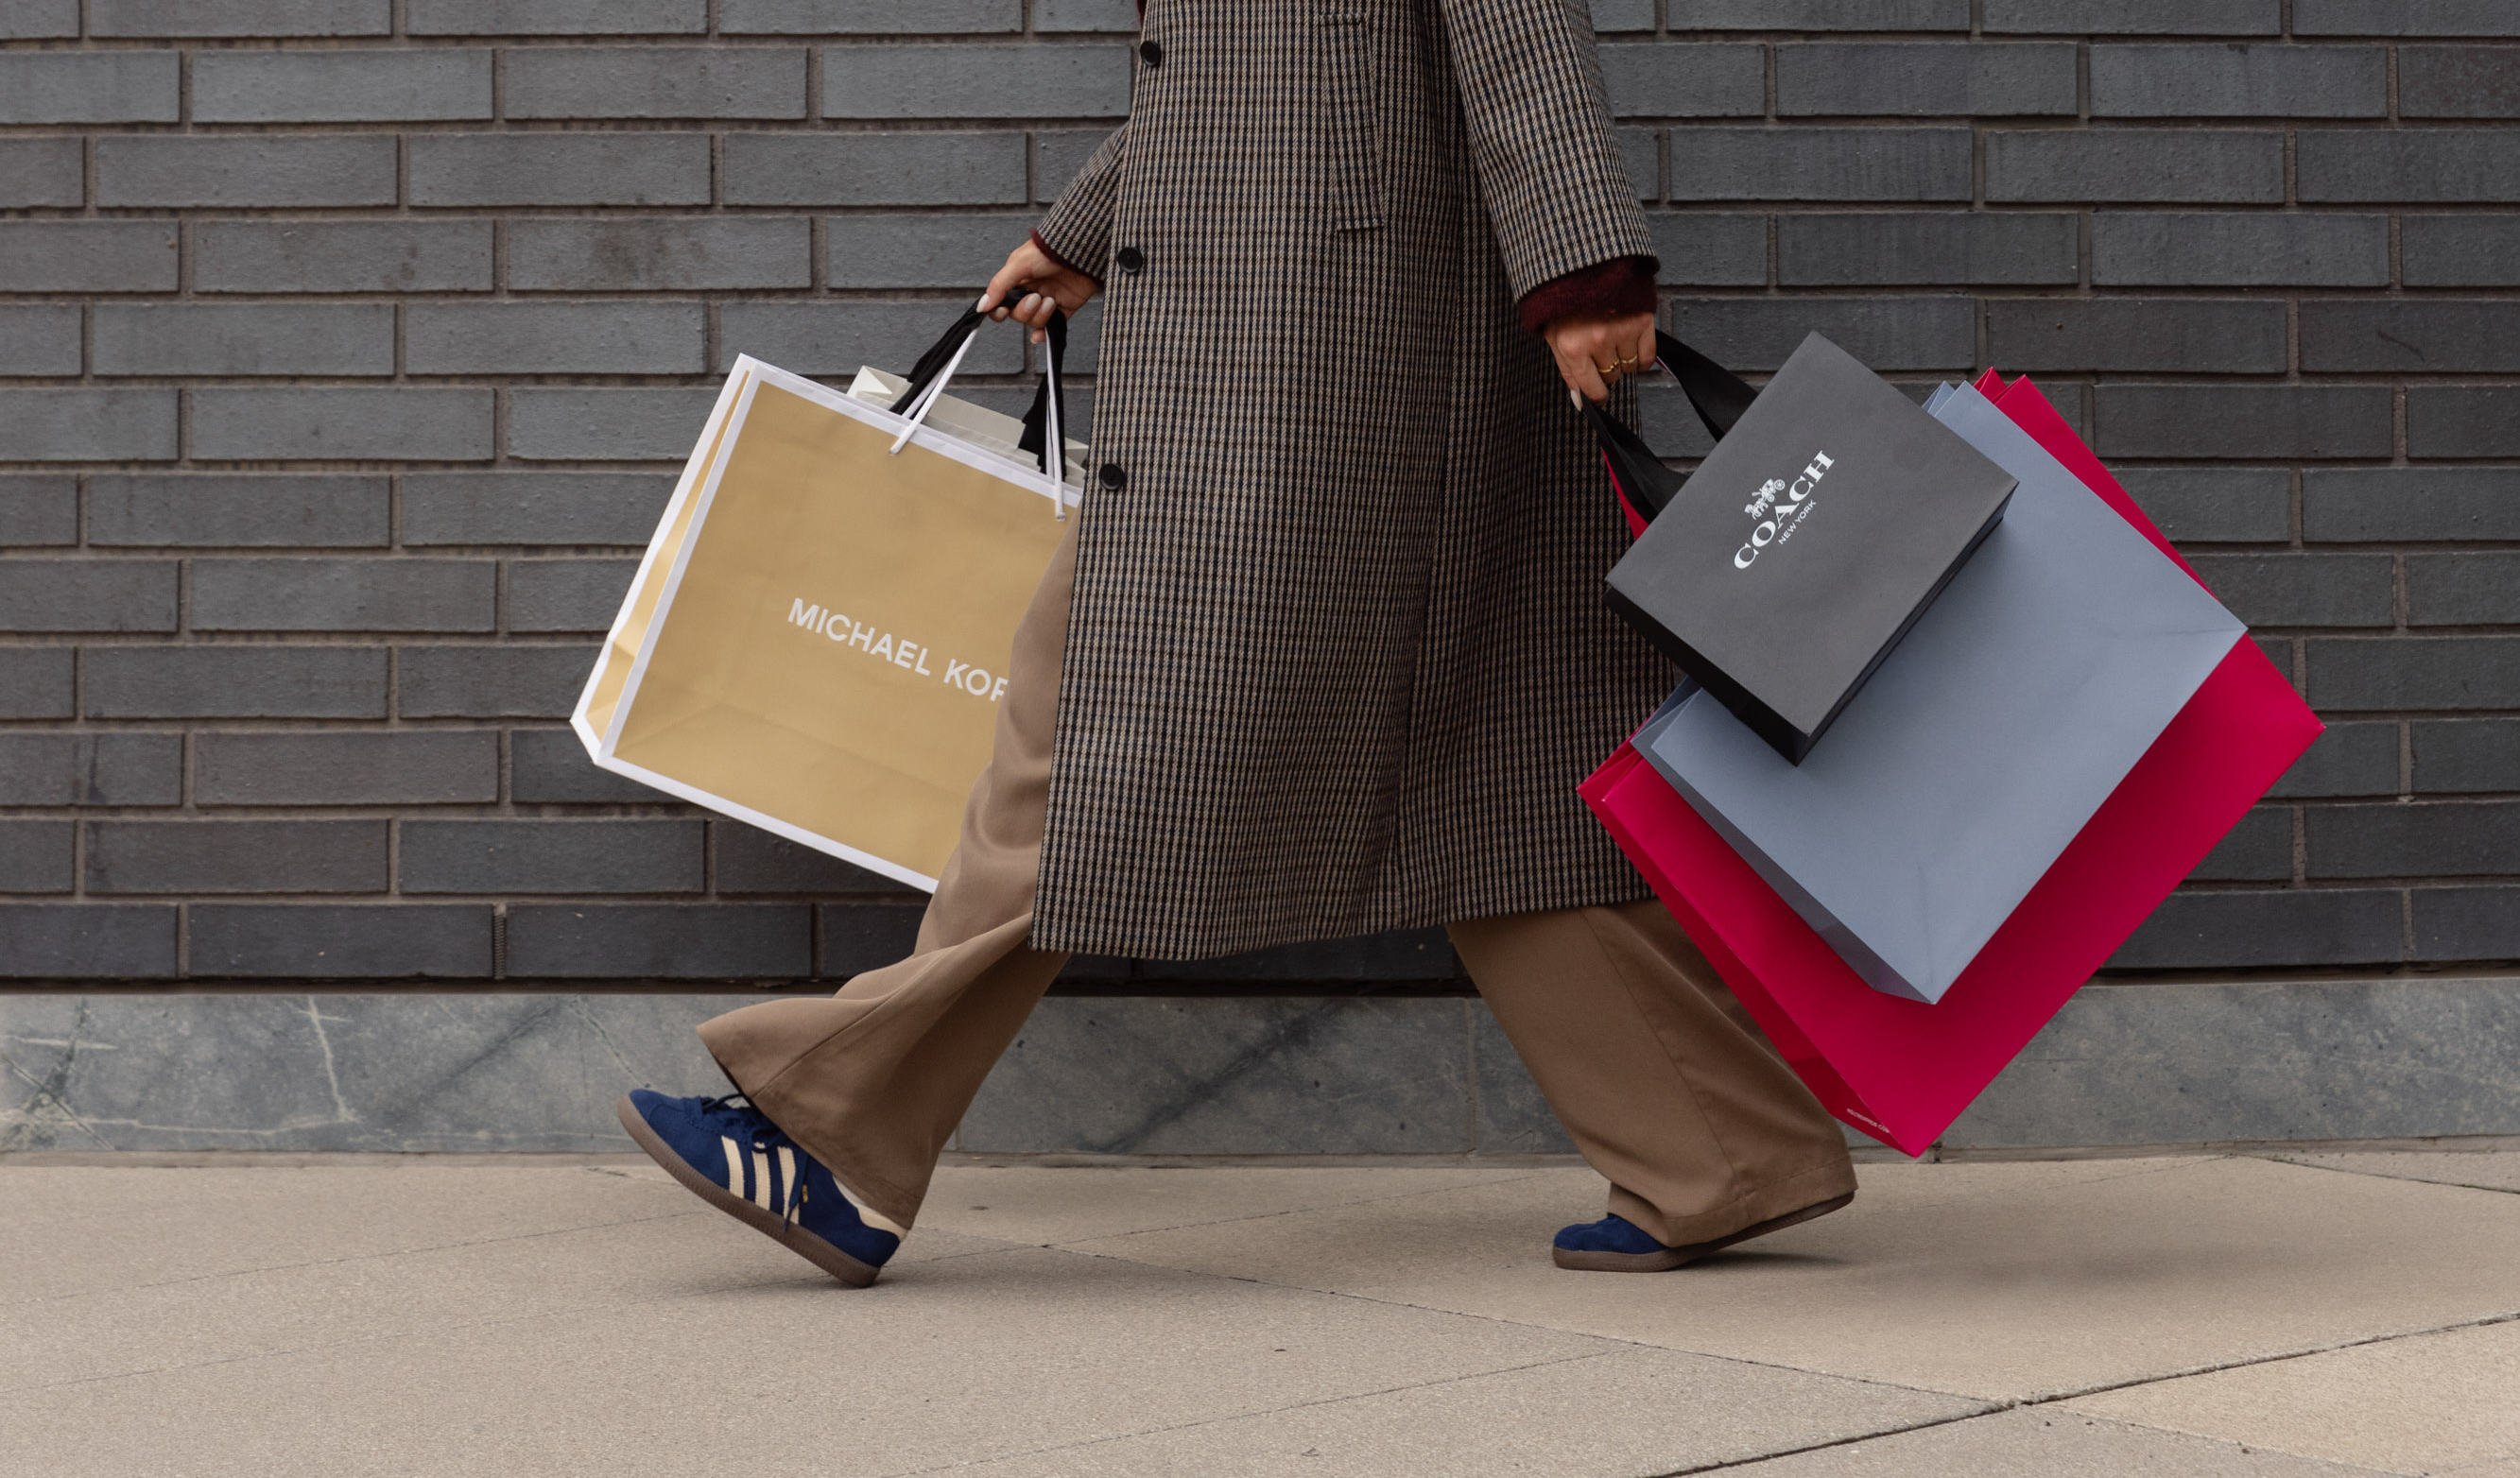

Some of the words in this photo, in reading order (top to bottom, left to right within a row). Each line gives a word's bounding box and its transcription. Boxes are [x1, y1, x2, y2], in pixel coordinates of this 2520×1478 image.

[1734, 450, 1835, 570] COACH
[1778, 522, 1797, 545] NEW
[1794, 499, 1817, 523] YORK
[787, 597, 931, 677] MICHAEL
